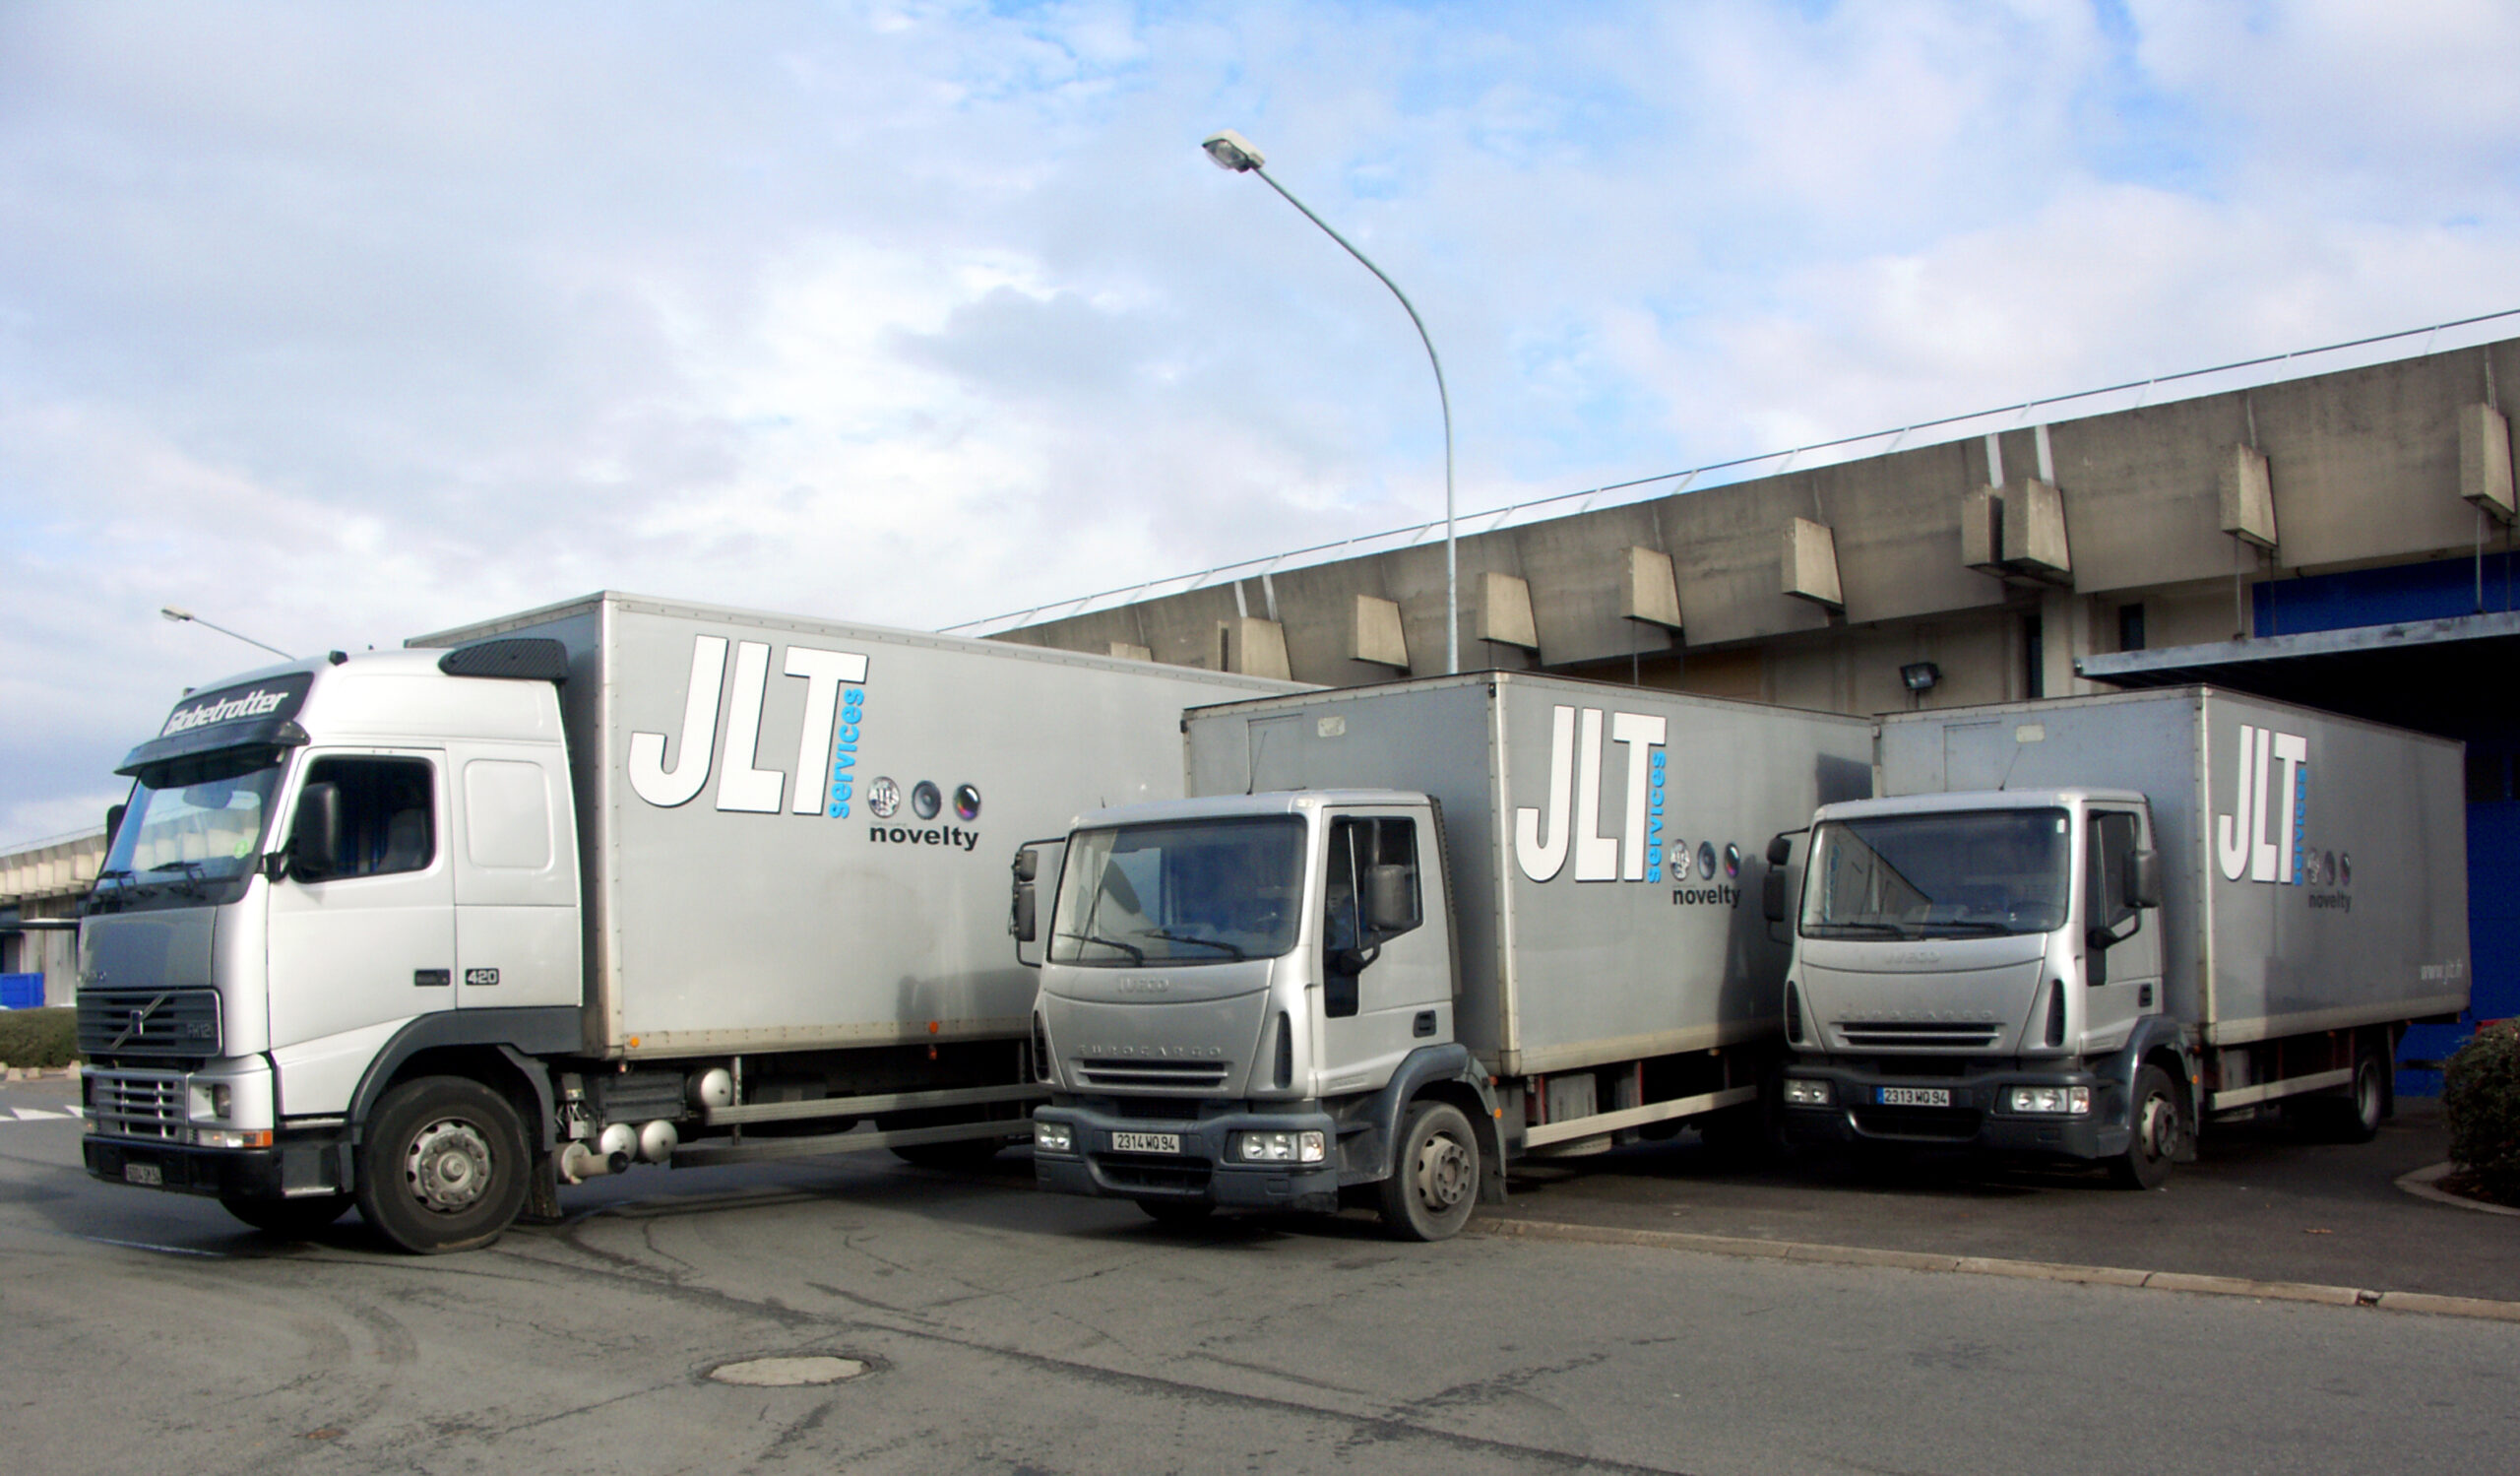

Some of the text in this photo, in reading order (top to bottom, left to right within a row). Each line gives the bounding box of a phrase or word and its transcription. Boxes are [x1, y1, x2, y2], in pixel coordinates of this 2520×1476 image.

[162, 689, 289, 737] Globetrotter
[629, 633, 868, 815] JLT
[829, 687, 865, 820] services
[1515, 704, 1667, 883] JLT
[2218, 725, 2307, 883] JLT
[1647, 750, 1667, 884] services
[869, 825, 979, 853] novelty
[1672, 883, 1741, 908] novelty
[2308, 891, 2352, 914] novelty
[467, 970, 498, 985] 420
[1884, 1089, 1913, 1104] 2313
[1931, 1090, 1947, 1105] 94
[1117, 1133, 1144, 1150] 2314
[1162, 1135, 1175, 1151] 94
